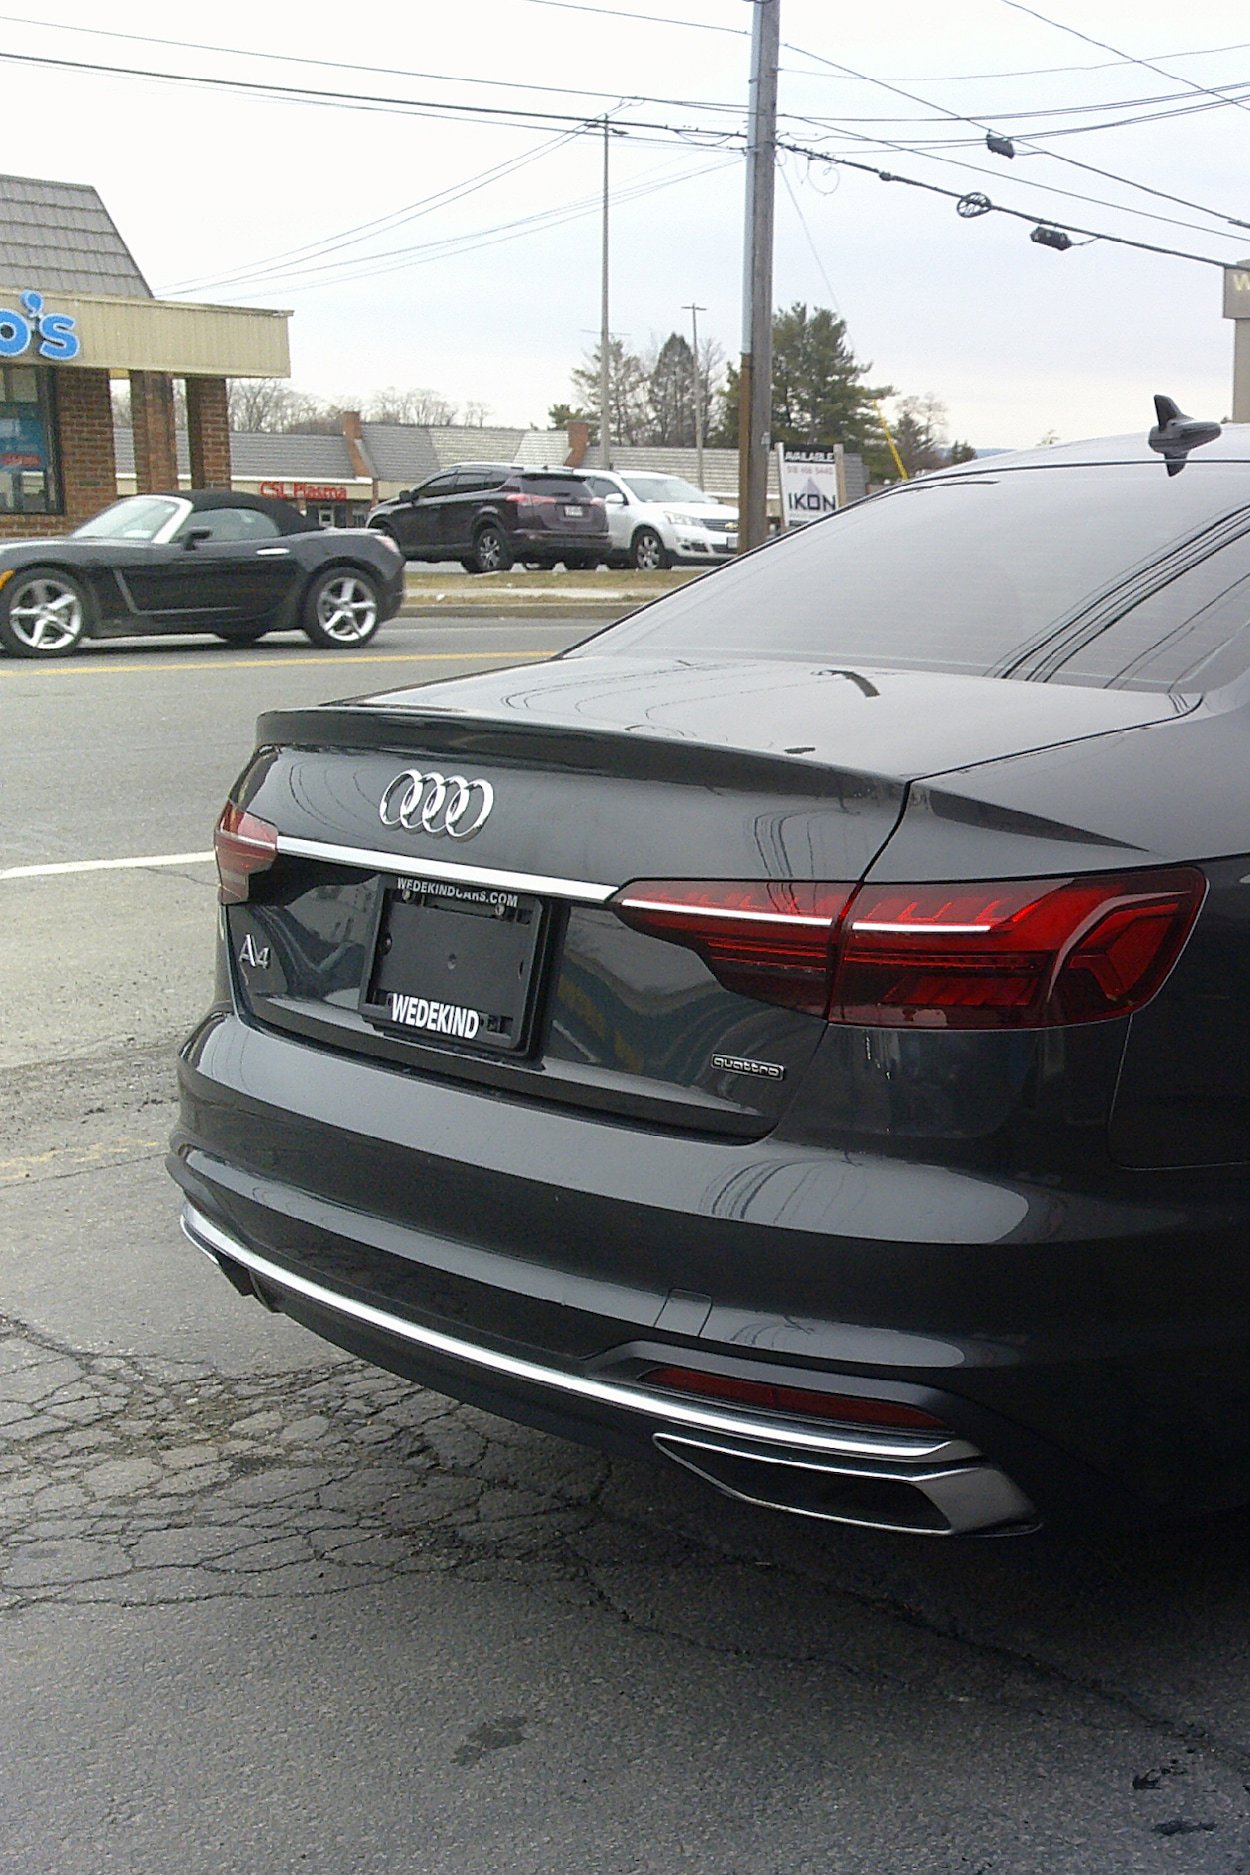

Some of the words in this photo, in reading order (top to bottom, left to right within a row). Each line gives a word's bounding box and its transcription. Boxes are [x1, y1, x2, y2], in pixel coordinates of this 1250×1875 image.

[259, 481, 289, 499] CSL
[293, 482, 347, 500] Plasma
[788, 493, 836, 512] IKON
[239, 933, 270, 969] A4
[391, 992, 480, 1040] WEDEKIND
[713, 1056, 780, 1078] quattro
